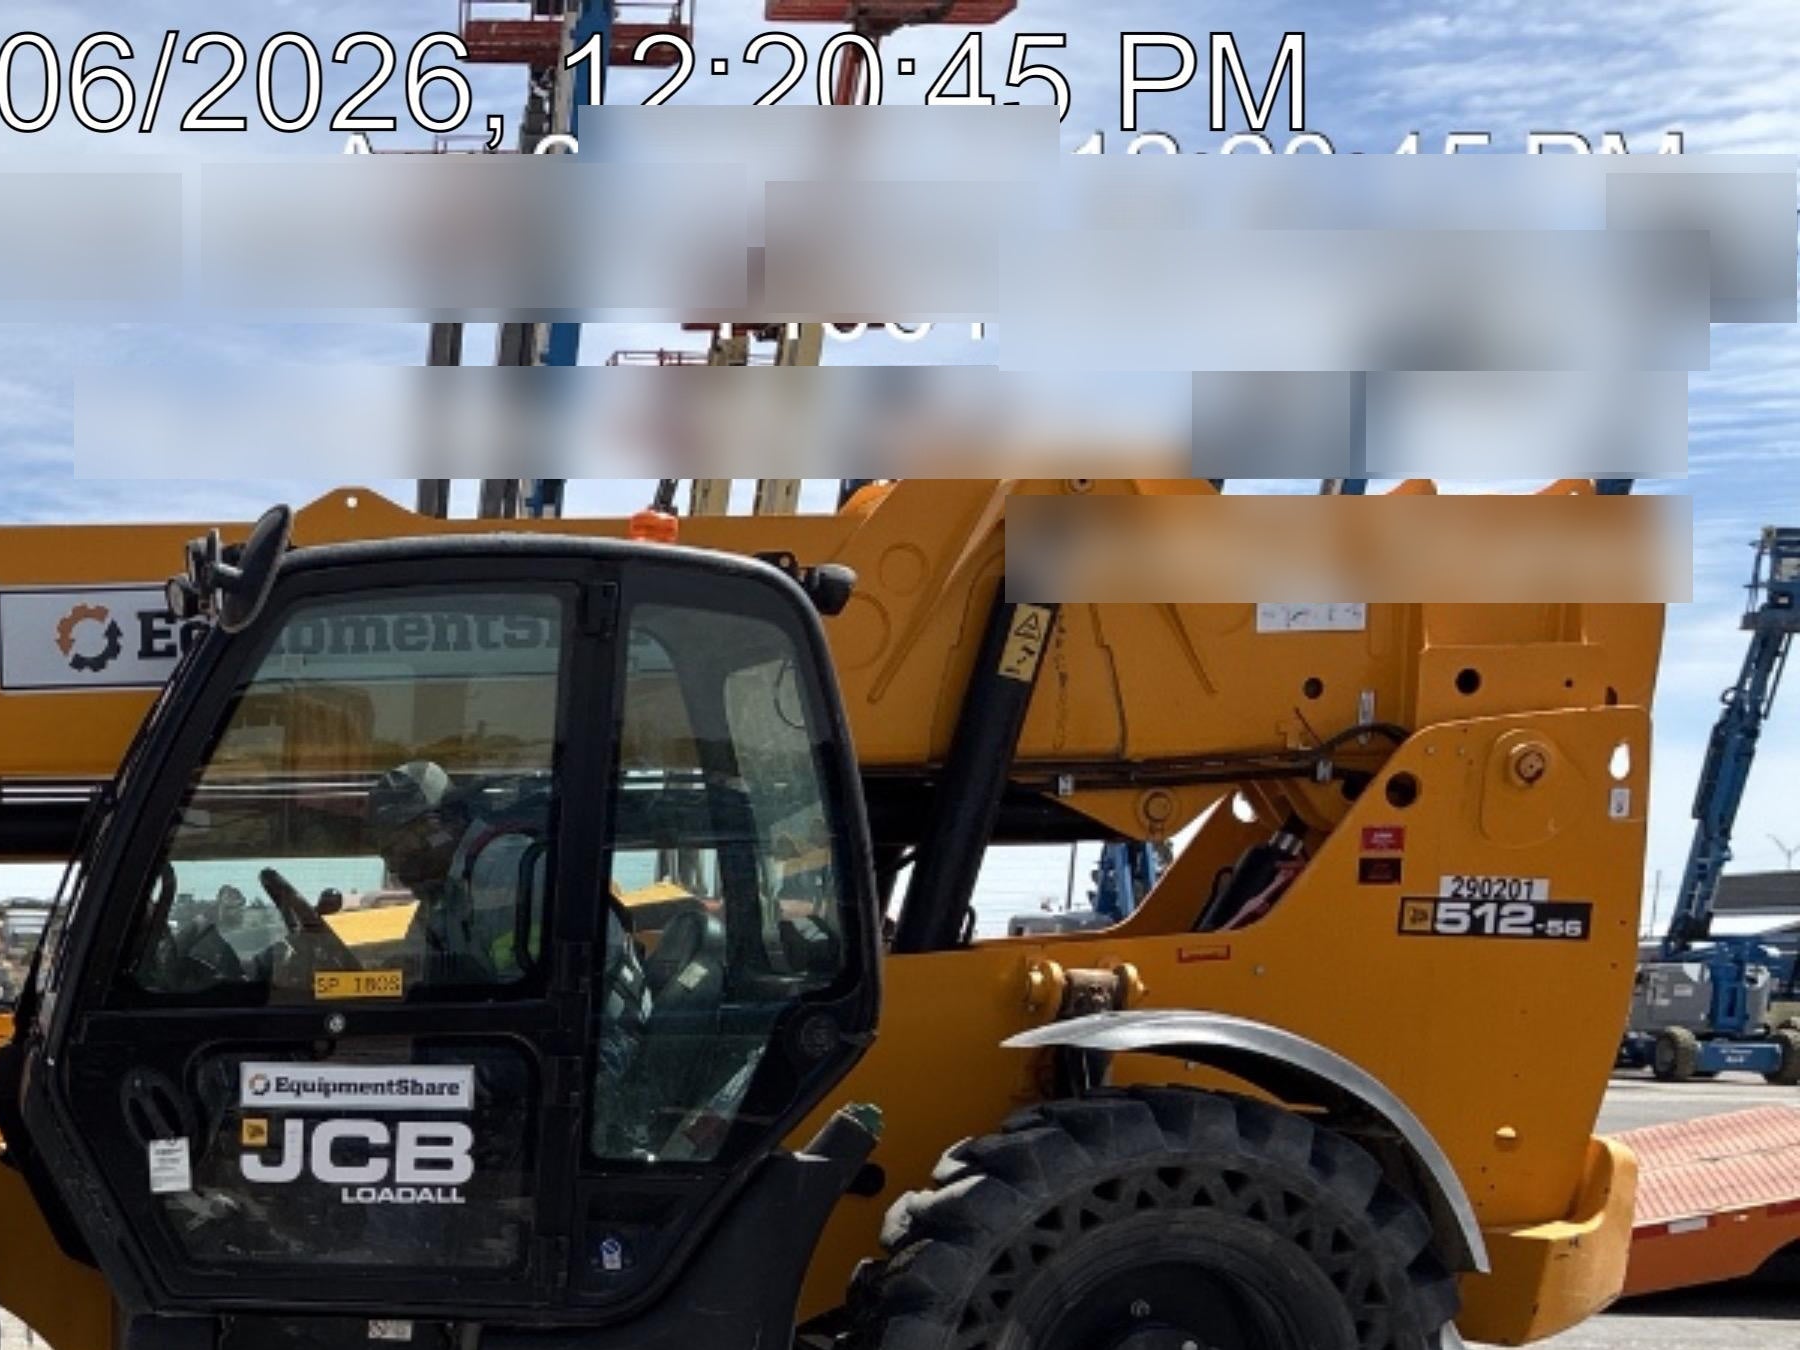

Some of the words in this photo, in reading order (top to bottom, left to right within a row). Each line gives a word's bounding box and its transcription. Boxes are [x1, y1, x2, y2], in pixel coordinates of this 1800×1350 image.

[1451, 875, 1534, 901] 290201
[275, 1076, 461, 1098] EquipmentShare
[240, 1119, 475, 1183] JCB
[340, 1187, 466, 1204] LOADALL
